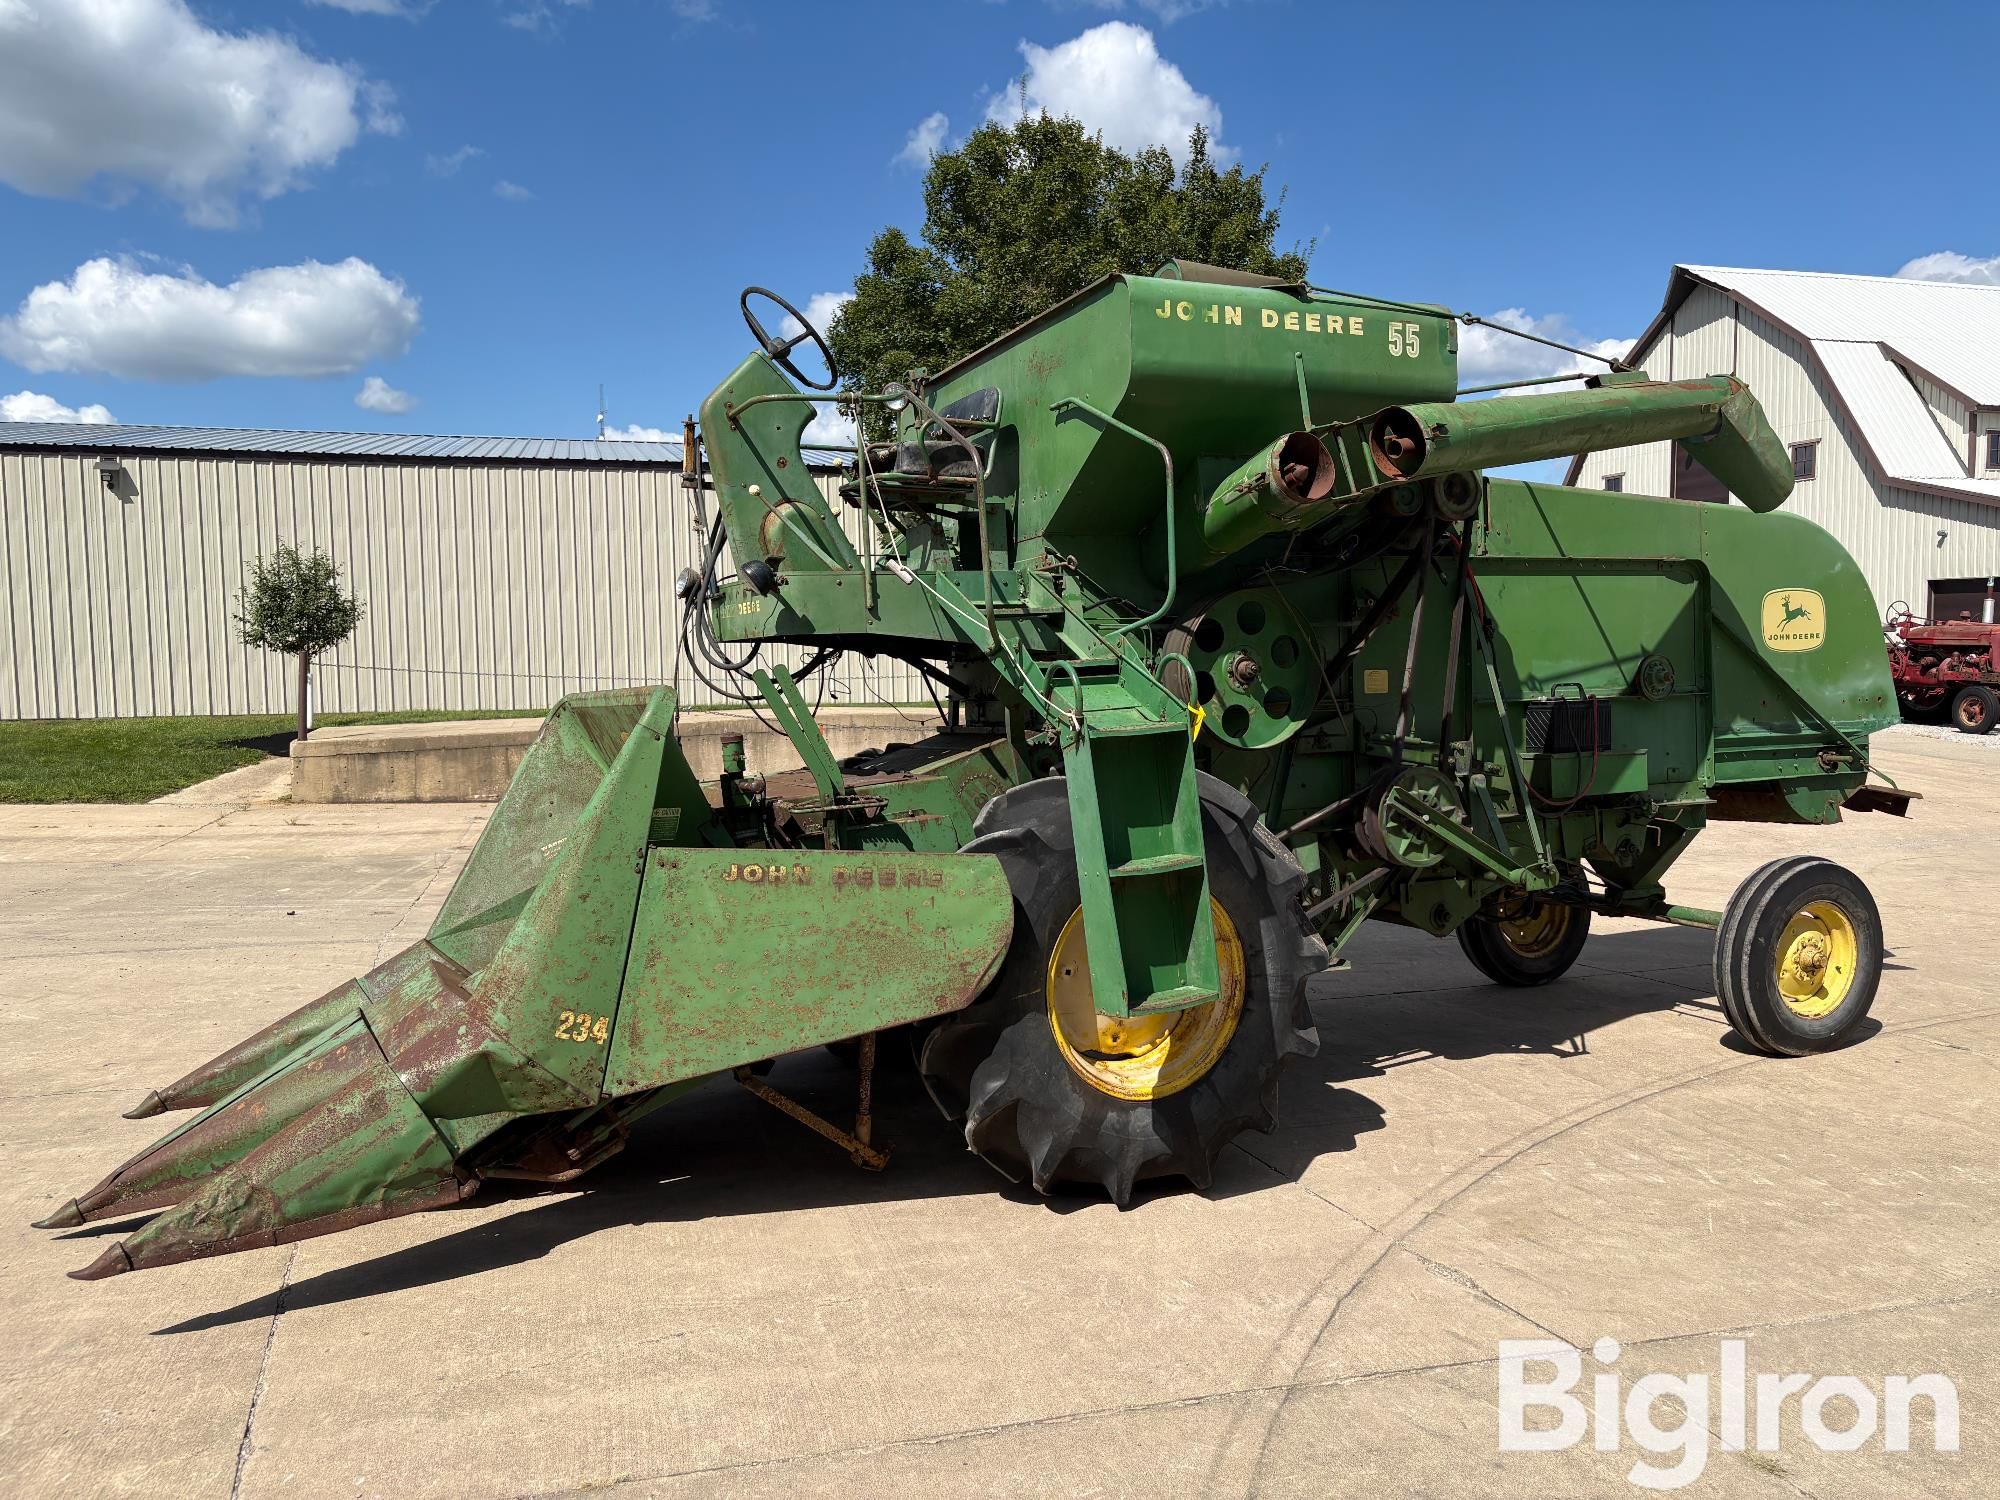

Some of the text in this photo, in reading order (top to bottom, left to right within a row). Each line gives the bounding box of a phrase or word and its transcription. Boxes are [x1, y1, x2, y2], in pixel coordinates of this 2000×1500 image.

[1155, 299, 1364, 336] JOHN DEERE
[1388, 321, 1420, 358] 55
[738, 600, 760, 615] DEERE
[722, 863, 811, 883] JOHN
[554, 1010, 609, 1045] 234
